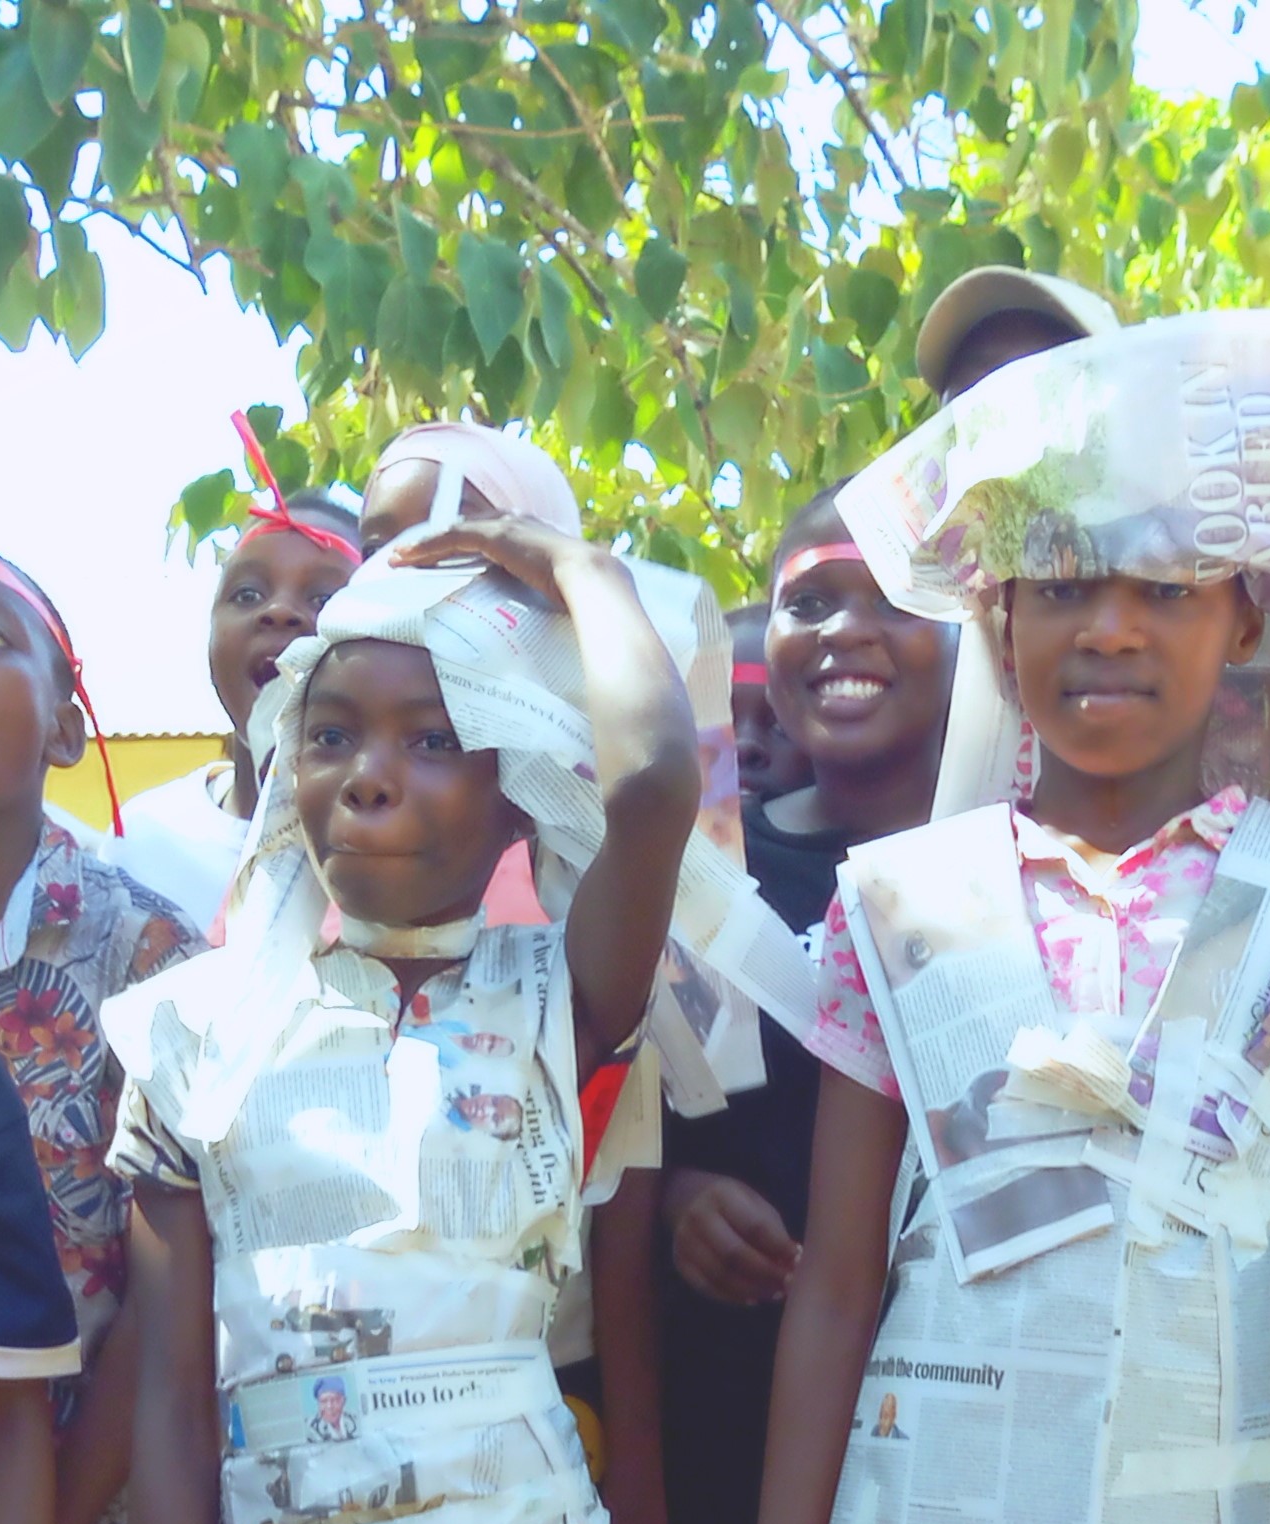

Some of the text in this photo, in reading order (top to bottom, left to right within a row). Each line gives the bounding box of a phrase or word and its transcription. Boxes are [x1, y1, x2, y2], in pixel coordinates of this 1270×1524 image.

[914, 1361, 1005, 1391] community
[372, 1388, 426, 1412] Ruto
[432, 1385, 454, 1404] to
